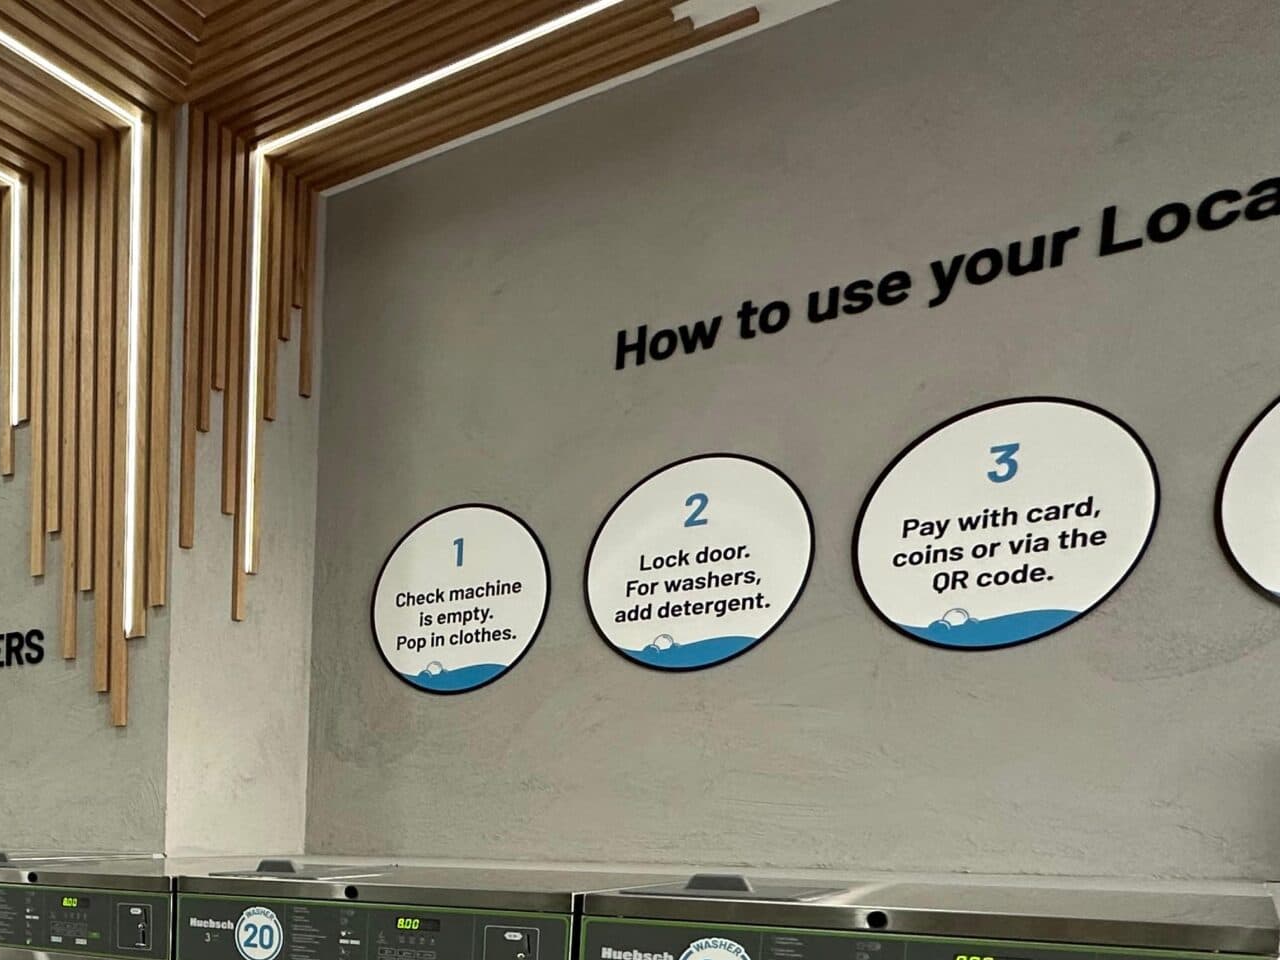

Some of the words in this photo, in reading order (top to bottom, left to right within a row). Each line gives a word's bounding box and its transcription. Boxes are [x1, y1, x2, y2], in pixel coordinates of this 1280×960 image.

[614, 315, 721, 370] How
[737, 299, 790, 339] to
[807, 270, 911, 323] use
[928, 225, 1078, 308] your
[986, 443, 1020, 484] 3
[683, 493, 709, 528] 2
[901, 516, 951, 542] Pay
[958, 506, 1018, 533] with
[1026, 496, 1102, 523] card,
[453, 538, 464, 567] 1
[638, 550, 691, 572] Lock
[696, 542, 751, 566] door.
[891, 542, 964, 570] coins
[970, 539, 1001, 561] or
[1008, 530, 1051, 555] via
[1057, 526, 1107, 551] the
[625, 576, 659, 598] For
[663, 567, 762, 596] washers,
[931, 570, 971, 594] QR
[976, 563, 1055, 588] code.
[396, 588, 445, 608] Check
[449, 580, 522, 601] machine
[614, 603, 652, 625] add
[657, 592, 771, 624] detergent.
[419, 612, 433, 627] is
[437, 606, 494, 626] empty.
[396, 635, 427, 653] Pop
[431, 632, 445, 648] in
[449, 628, 517, 645] clothes.
[190, 917, 234, 930] Huebsch
[243, 923, 274, 949] 20
[693, 939, 743, 957] WASHER
